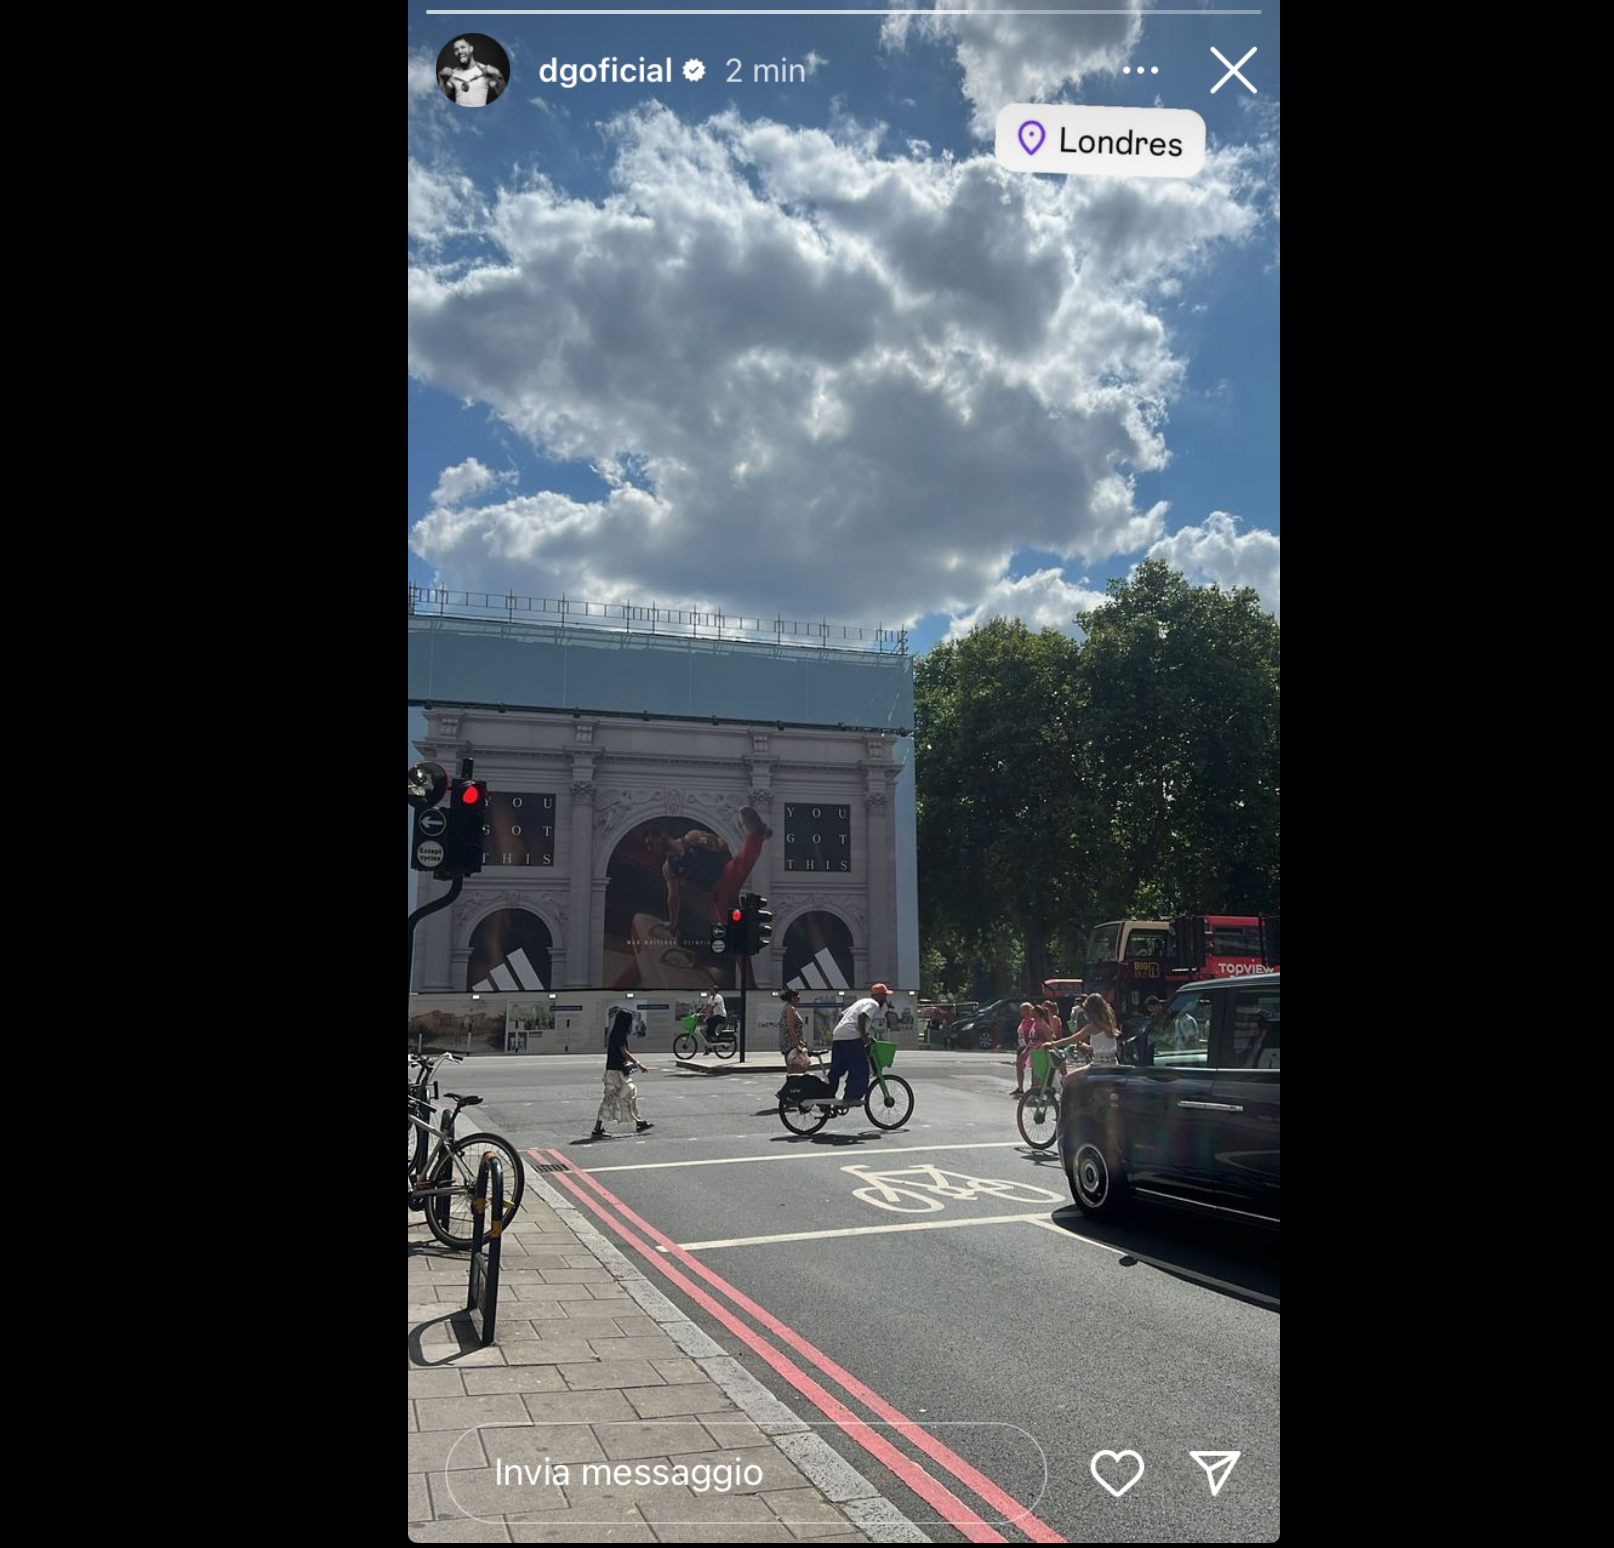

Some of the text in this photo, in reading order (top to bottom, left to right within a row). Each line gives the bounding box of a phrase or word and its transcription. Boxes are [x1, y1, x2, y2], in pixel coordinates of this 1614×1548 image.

[484, 796, 553, 809] YOU
[786, 806, 846, 819] YOU
[482, 824, 553, 837] GOT
[786, 833, 847, 845] GOT
[482, 853, 551, 865] THIS
[786, 859, 848, 871] THIS
